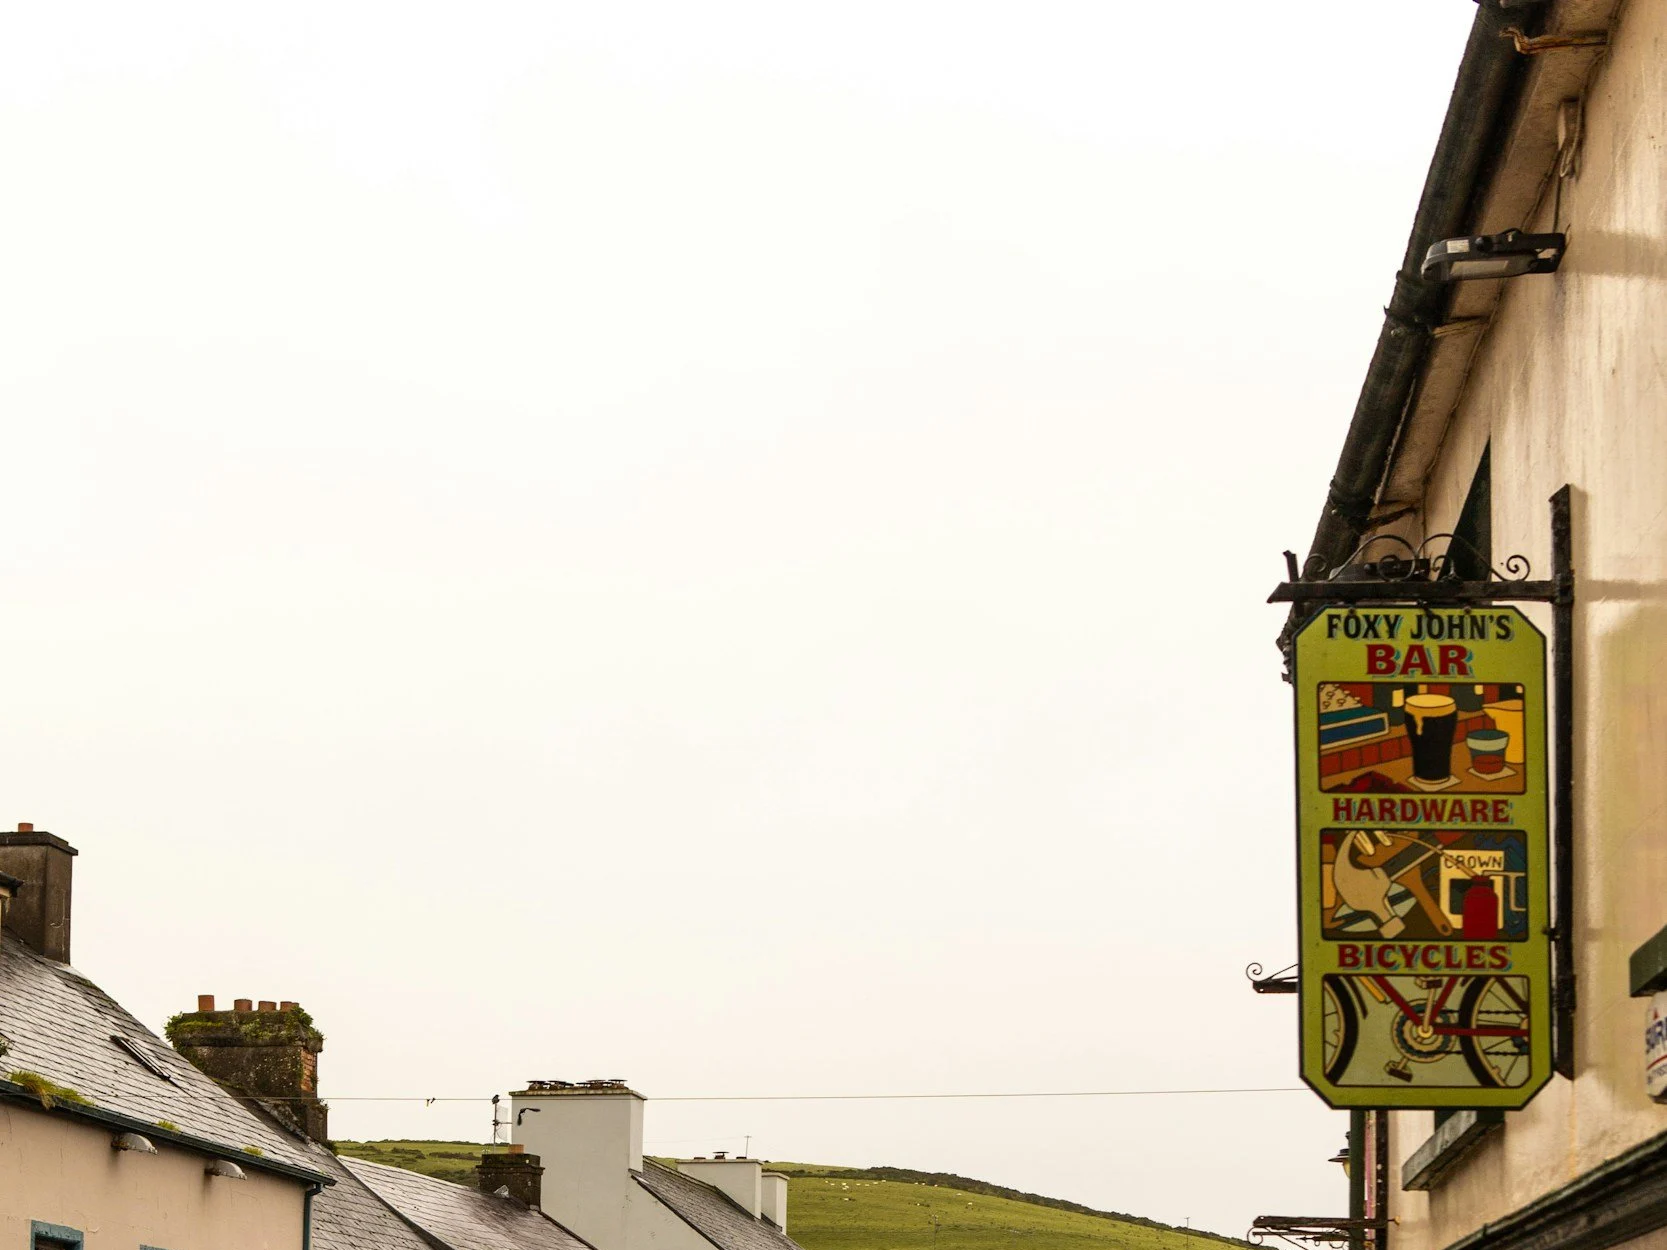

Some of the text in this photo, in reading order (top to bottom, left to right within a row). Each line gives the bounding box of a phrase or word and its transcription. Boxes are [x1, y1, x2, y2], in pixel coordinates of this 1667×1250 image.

[1327, 613, 1513, 641] FOXY JOHN'S
[1365, 643, 1474, 678] BAR
[1332, 797, 1513, 825] HARDWARE
[1444, 854, 1503, 869] CROWN
[1337, 943, 1512, 972] BICYCLES
